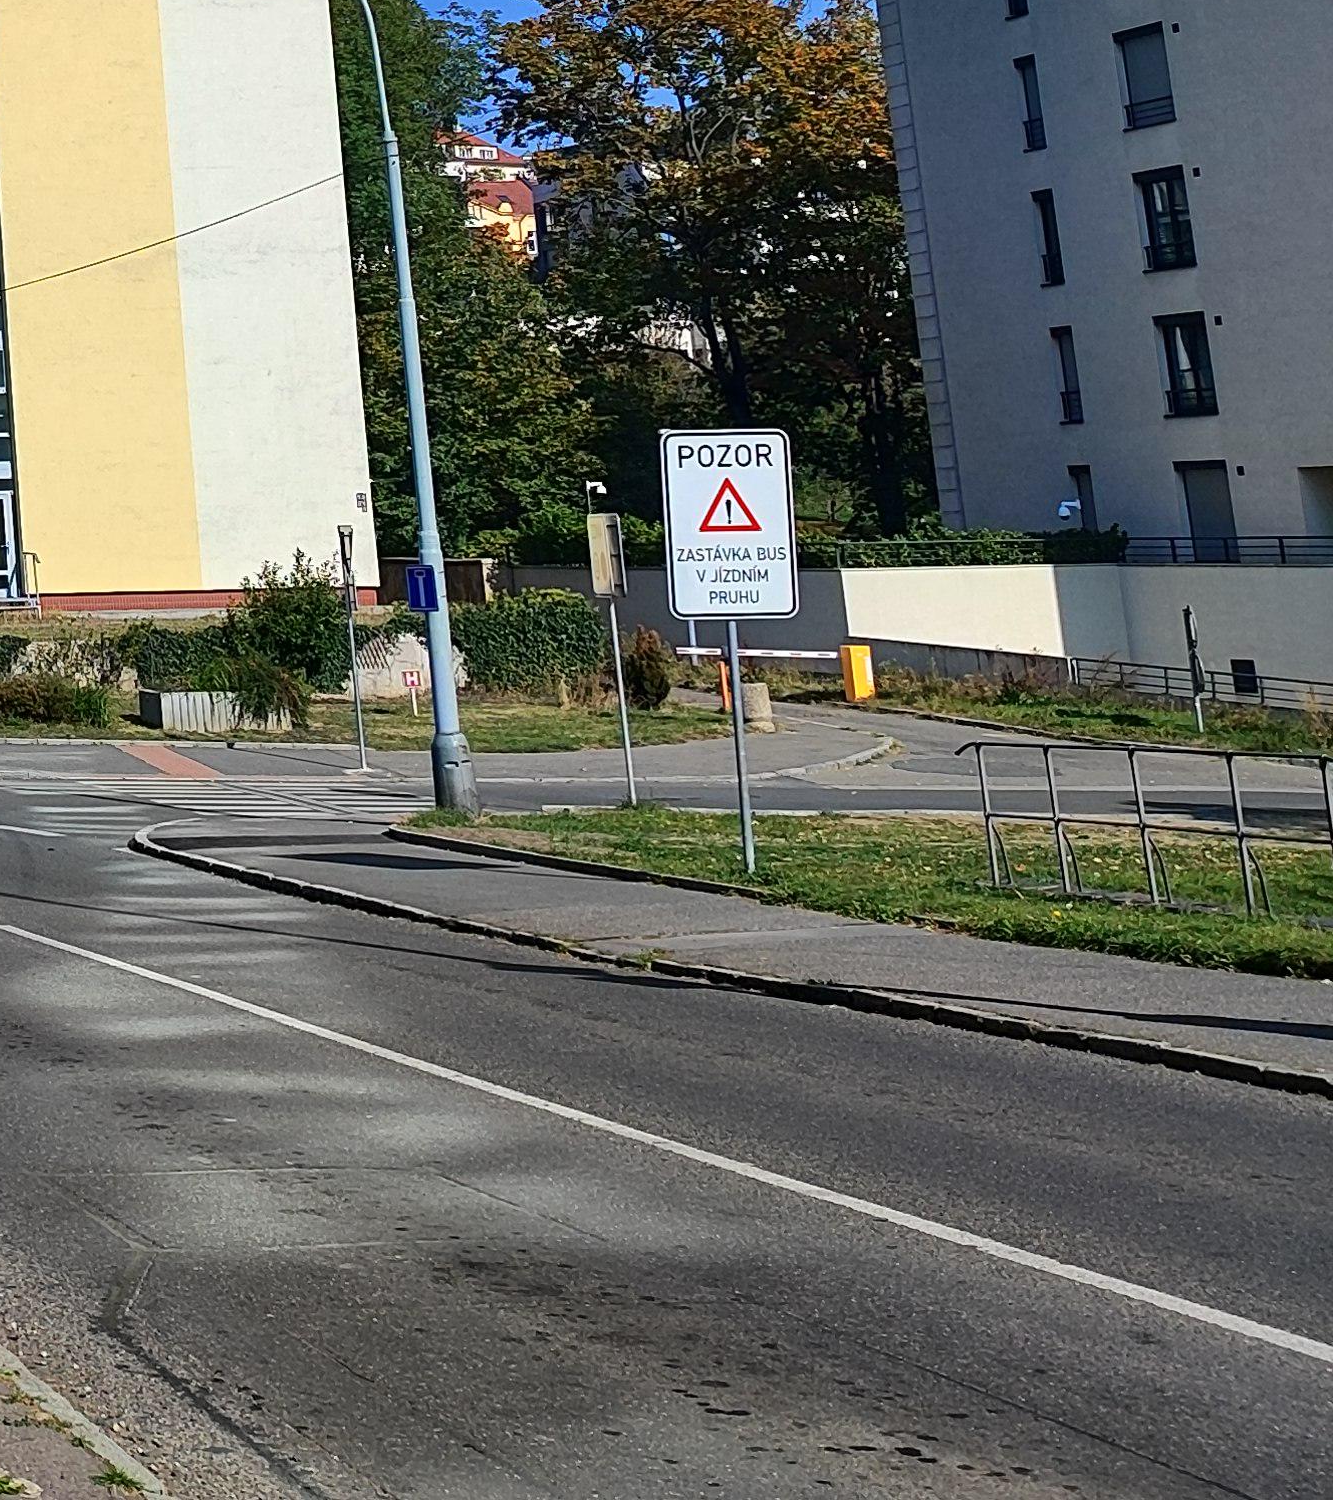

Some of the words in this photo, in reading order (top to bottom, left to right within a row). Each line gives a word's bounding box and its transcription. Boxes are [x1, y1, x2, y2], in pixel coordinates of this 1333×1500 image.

[677, 443, 774, 469] POZOR
[677, 544, 752, 562] ZASTÁVKA
[757, 547, 787, 561] BUS
[696, 569, 706, 583] V
[710, 565, 769, 583] JÍZDNÍM
[709, 590, 760, 604] PRUHU
